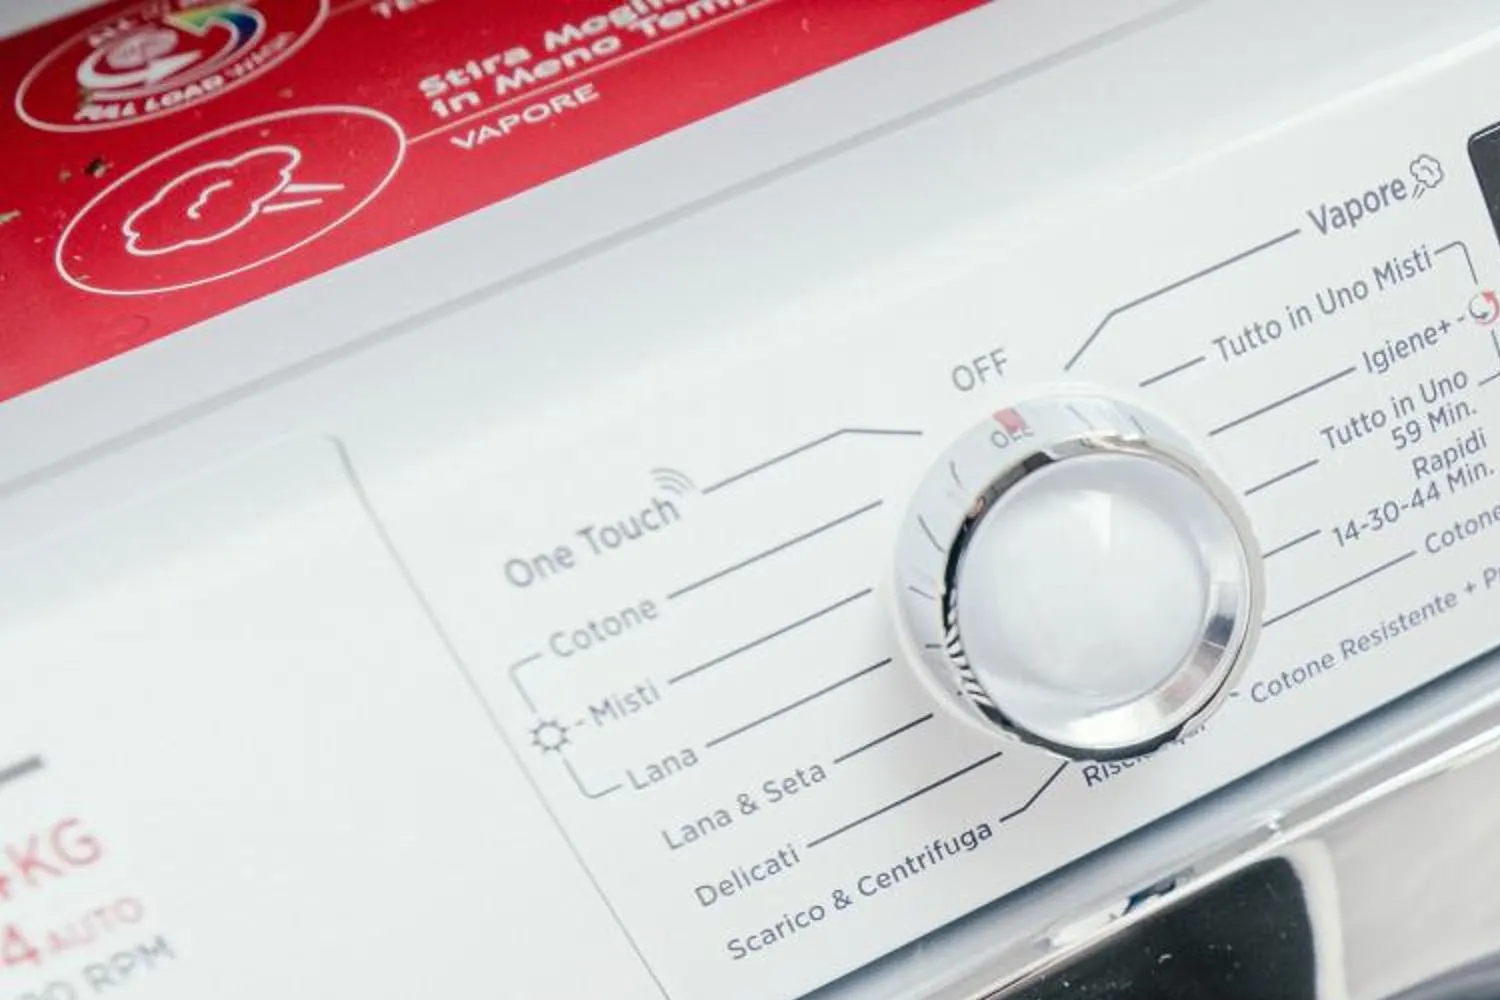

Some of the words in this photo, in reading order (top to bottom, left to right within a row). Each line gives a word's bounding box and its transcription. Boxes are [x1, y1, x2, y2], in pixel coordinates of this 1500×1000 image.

[418, 47, 532, 96] Stira
[495, 36, 621, 94] Meno
[450, 82, 600, 150] VAPORE
[1306, 175, 1408, 237] Vapore
[1212, 316, 1283, 368] Tutto
[1288, 301, 1315, 332] in
[1317, 274, 1370, 317] Uno
[1373, 242, 1434, 292] Misti
[951, 347, 1008, 392] OFF
[1362, 317, 1453, 376] Igiene+
[1320, 409, 1387, 450] Tutto
[1391, 396, 1416, 419] in
[1419, 369, 1469, 404] Uno
[1391, 419, 1423, 451] 59
[1427, 400, 1478, 434] Min.
[1412, 427, 1488, 480] Rapidi
[1332, 480, 1442, 548] 14-30-44
[1446, 461, 1495, 494] Min.
[504, 544, 576, 589] One
[575, 496, 682, 550] Touch
[548, 599, 659, 659] Cotone
[1250, 650, 1336, 705] Cotone
[1340, 590, 1458, 660] Resistente
[1463, 579, 1478, 596] +
[588, 678, 662, 729] Misti
[626, 744, 699, 793] Lana
[661, 806, 733, 852] Lana
[735, 793, 760, 817] &
[762, 760, 828, 804] Seta
[0, 816, 102, 898] KG
[693, 841, 802, 909] Delicati
[727, 901, 826, 961] Scarico
[830, 888, 853, 911] &
[856, 821, 994, 898] Centrifuga
